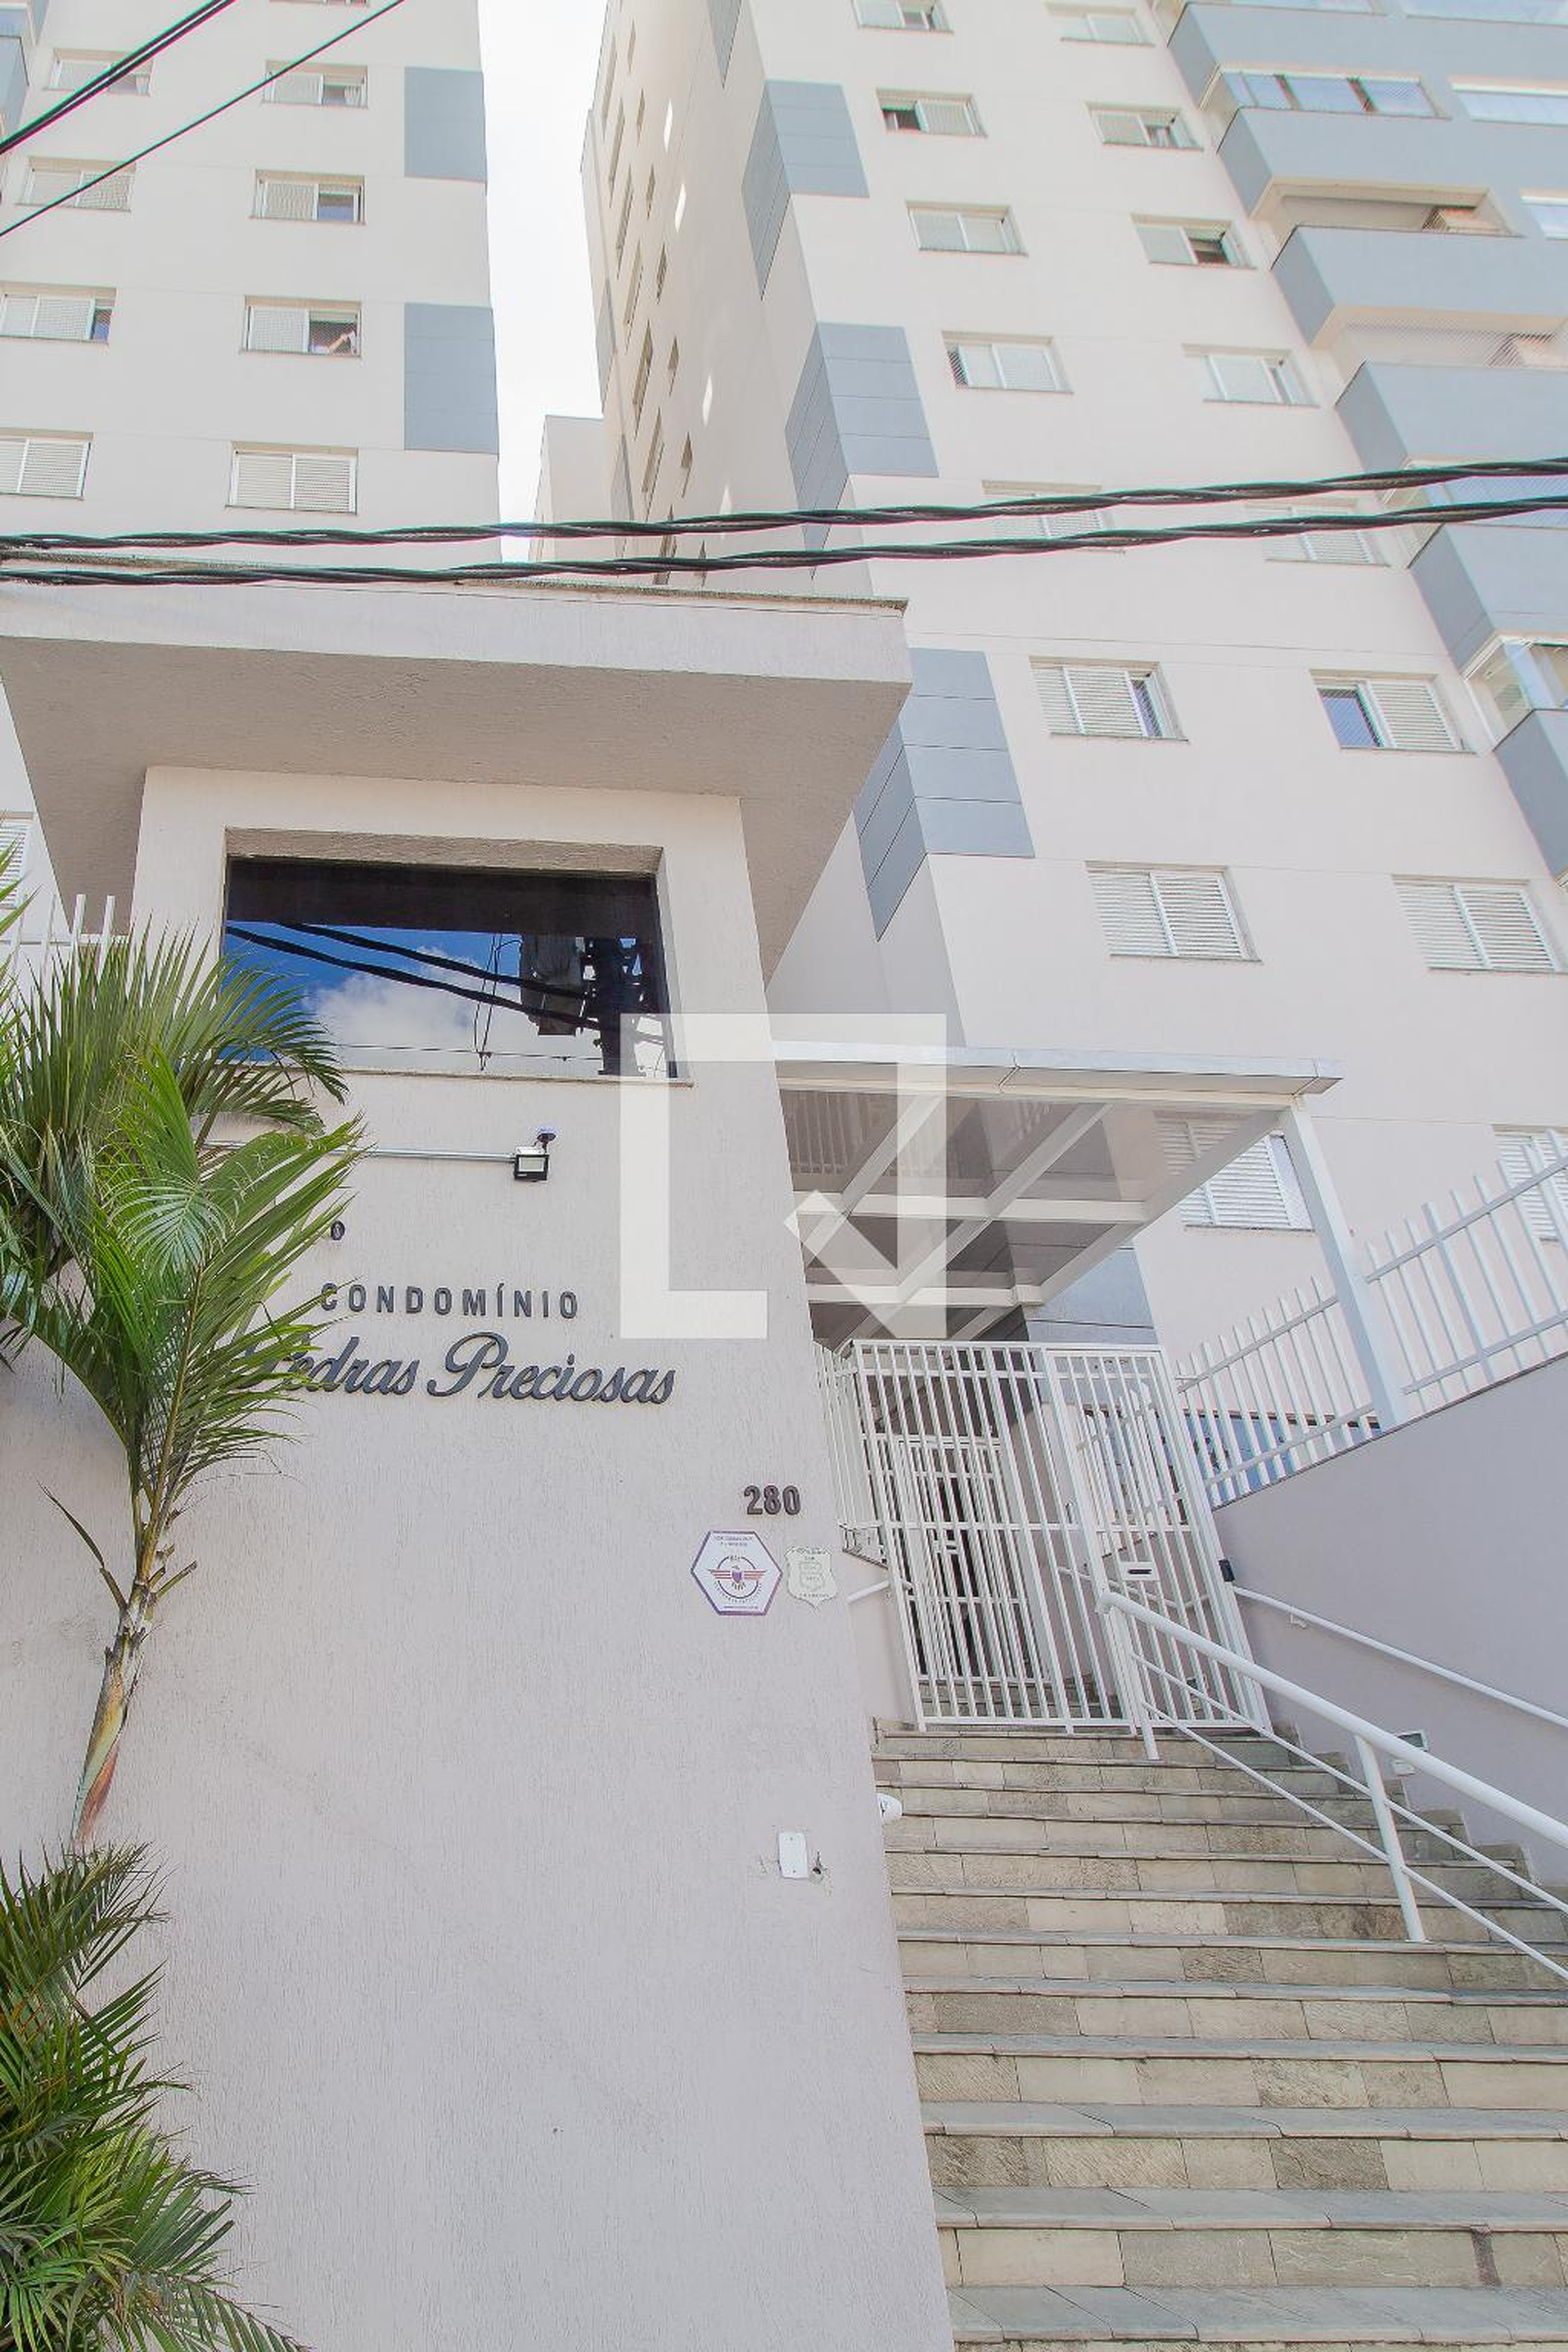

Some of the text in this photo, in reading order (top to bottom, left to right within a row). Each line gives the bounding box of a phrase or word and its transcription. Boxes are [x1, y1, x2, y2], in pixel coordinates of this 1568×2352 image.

[322, 1282, 577, 1319] CONDOMÍNIO
[427, 1332, 675, 1404] Preciosas
[744, 1485, 801, 1515] 280
